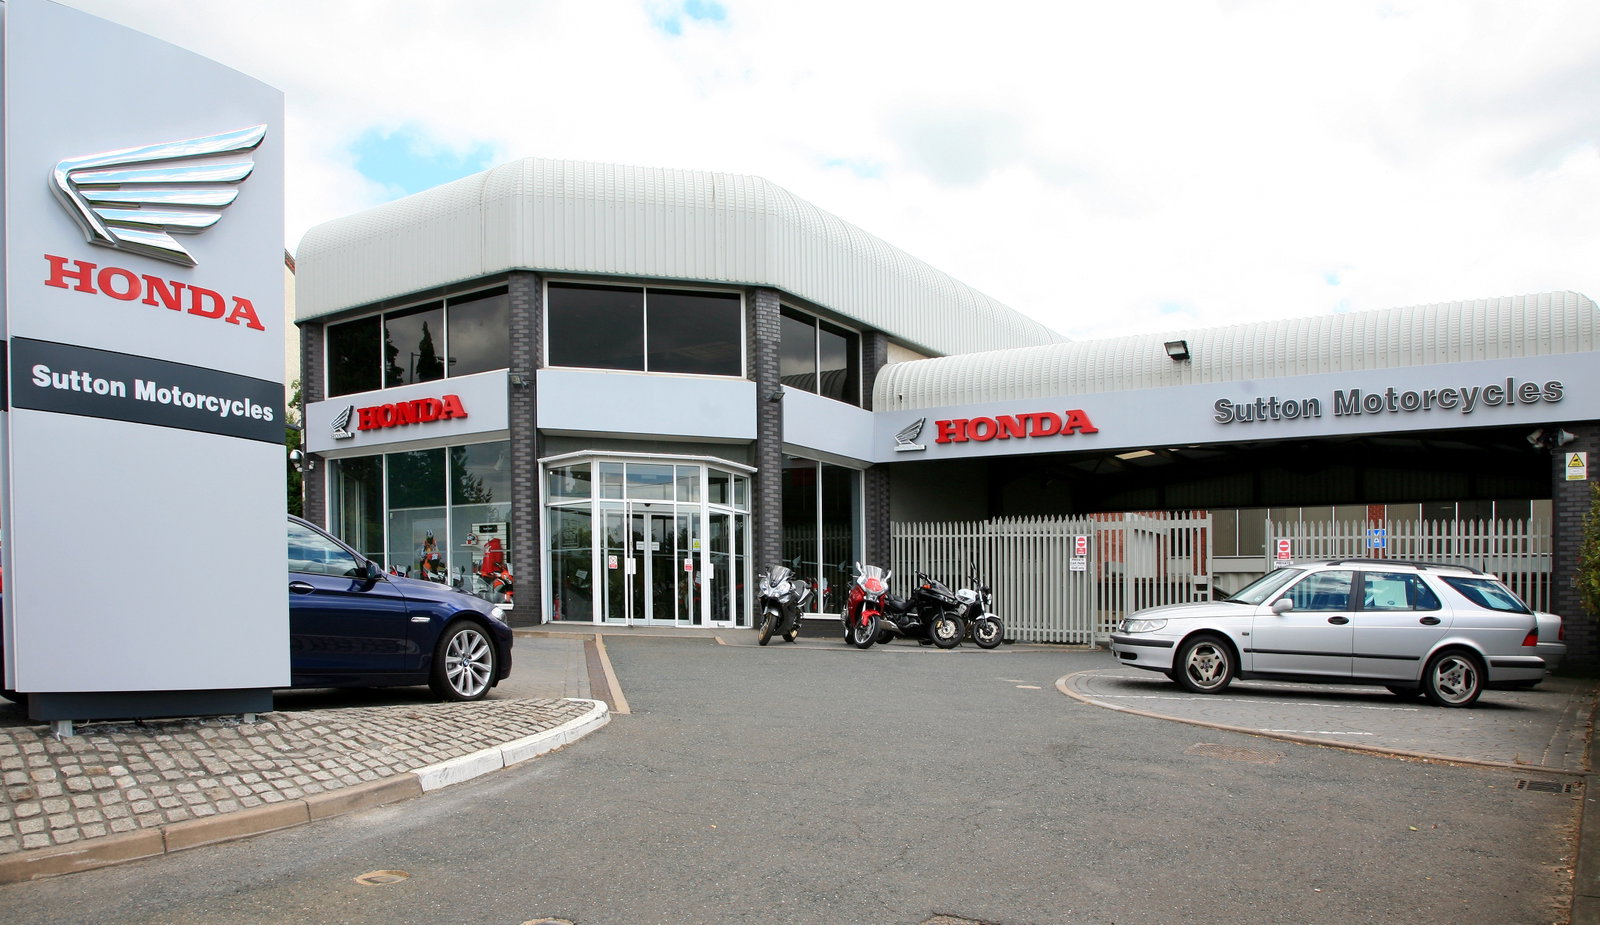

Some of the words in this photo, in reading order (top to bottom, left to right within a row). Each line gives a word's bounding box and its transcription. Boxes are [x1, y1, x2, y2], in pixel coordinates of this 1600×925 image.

[45, 254, 265, 331] HONDA
[32, 364, 126, 397] Sutton
[134, 379, 274, 422] Motorcycles
[357, 394, 468, 431] HONDA
[1213, 396, 1322, 424] Sutton
[1332, 376, 1564, 415] Motorcycles
[934, 409, 1099, 444] HONDA
